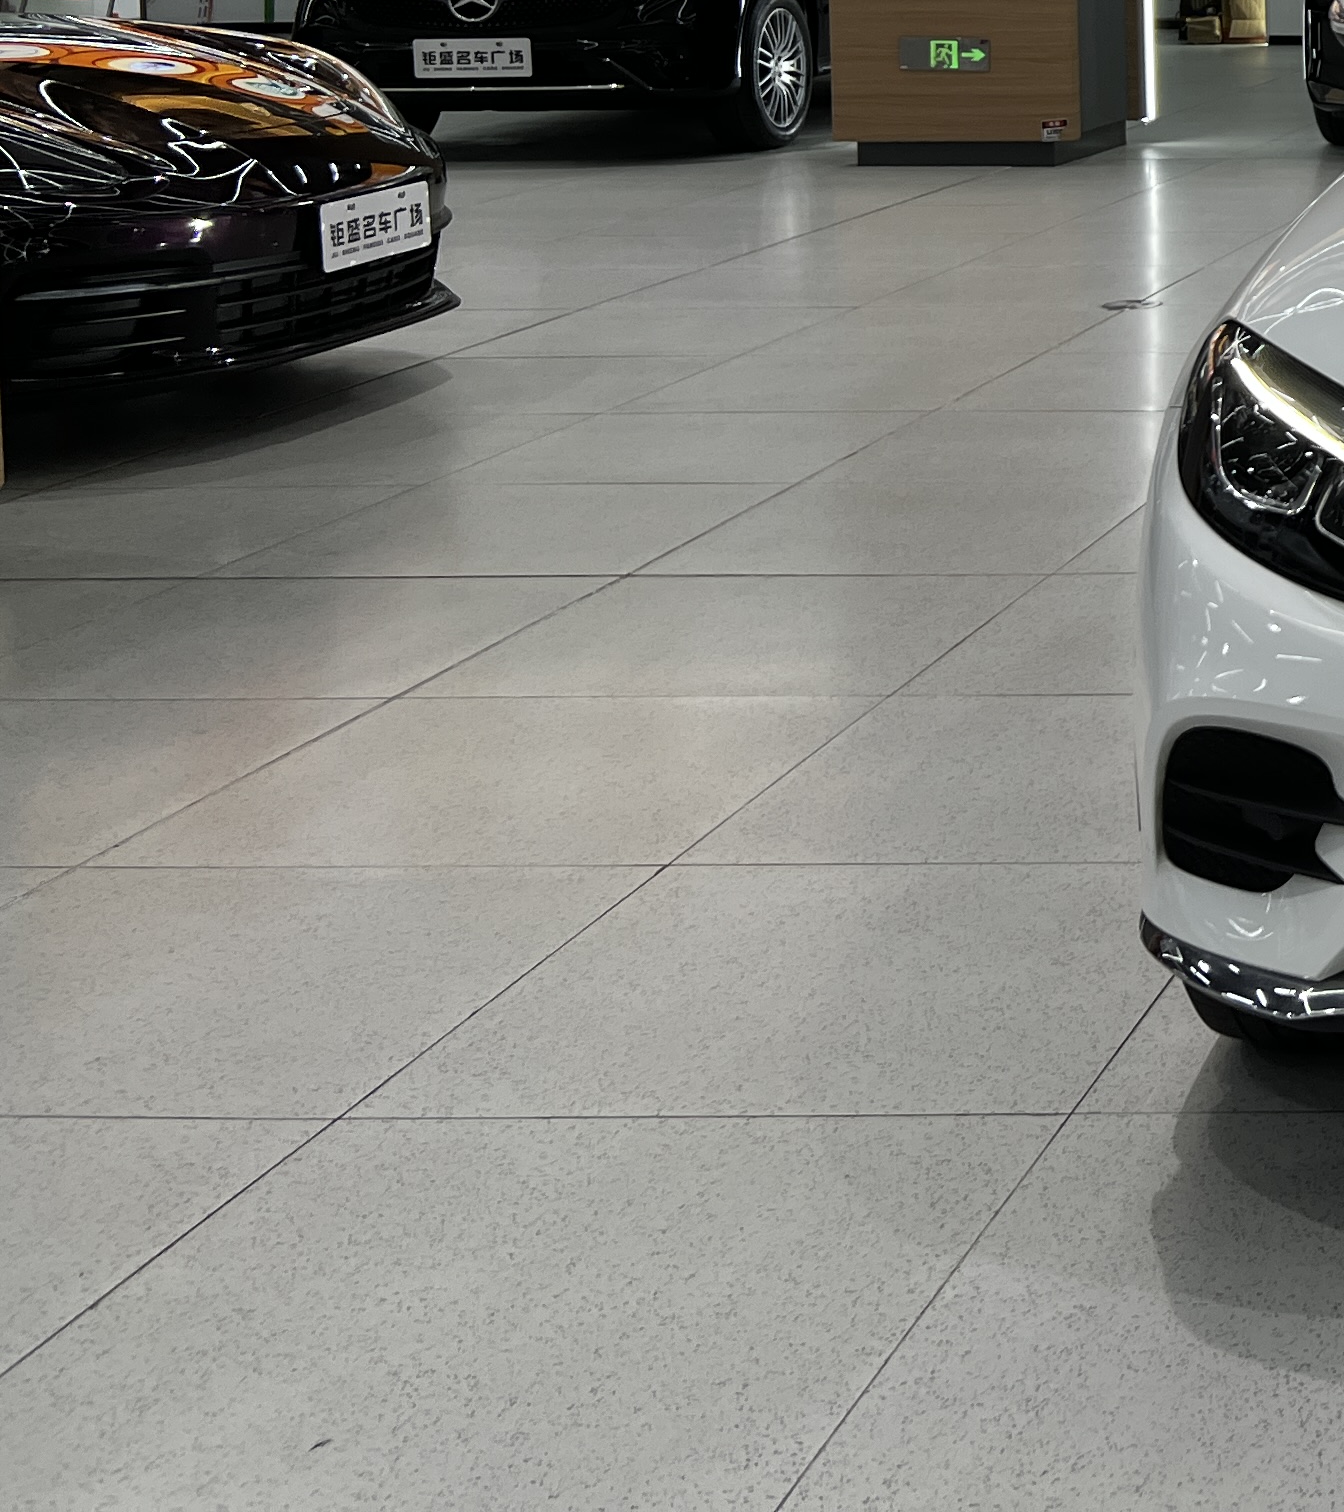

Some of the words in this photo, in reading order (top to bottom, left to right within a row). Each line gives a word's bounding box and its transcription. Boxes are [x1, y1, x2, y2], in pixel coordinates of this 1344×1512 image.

[421, 49, 524, 66] 钜盛名车广场
[329, 202, 424, 248] 钜盛名车广场
